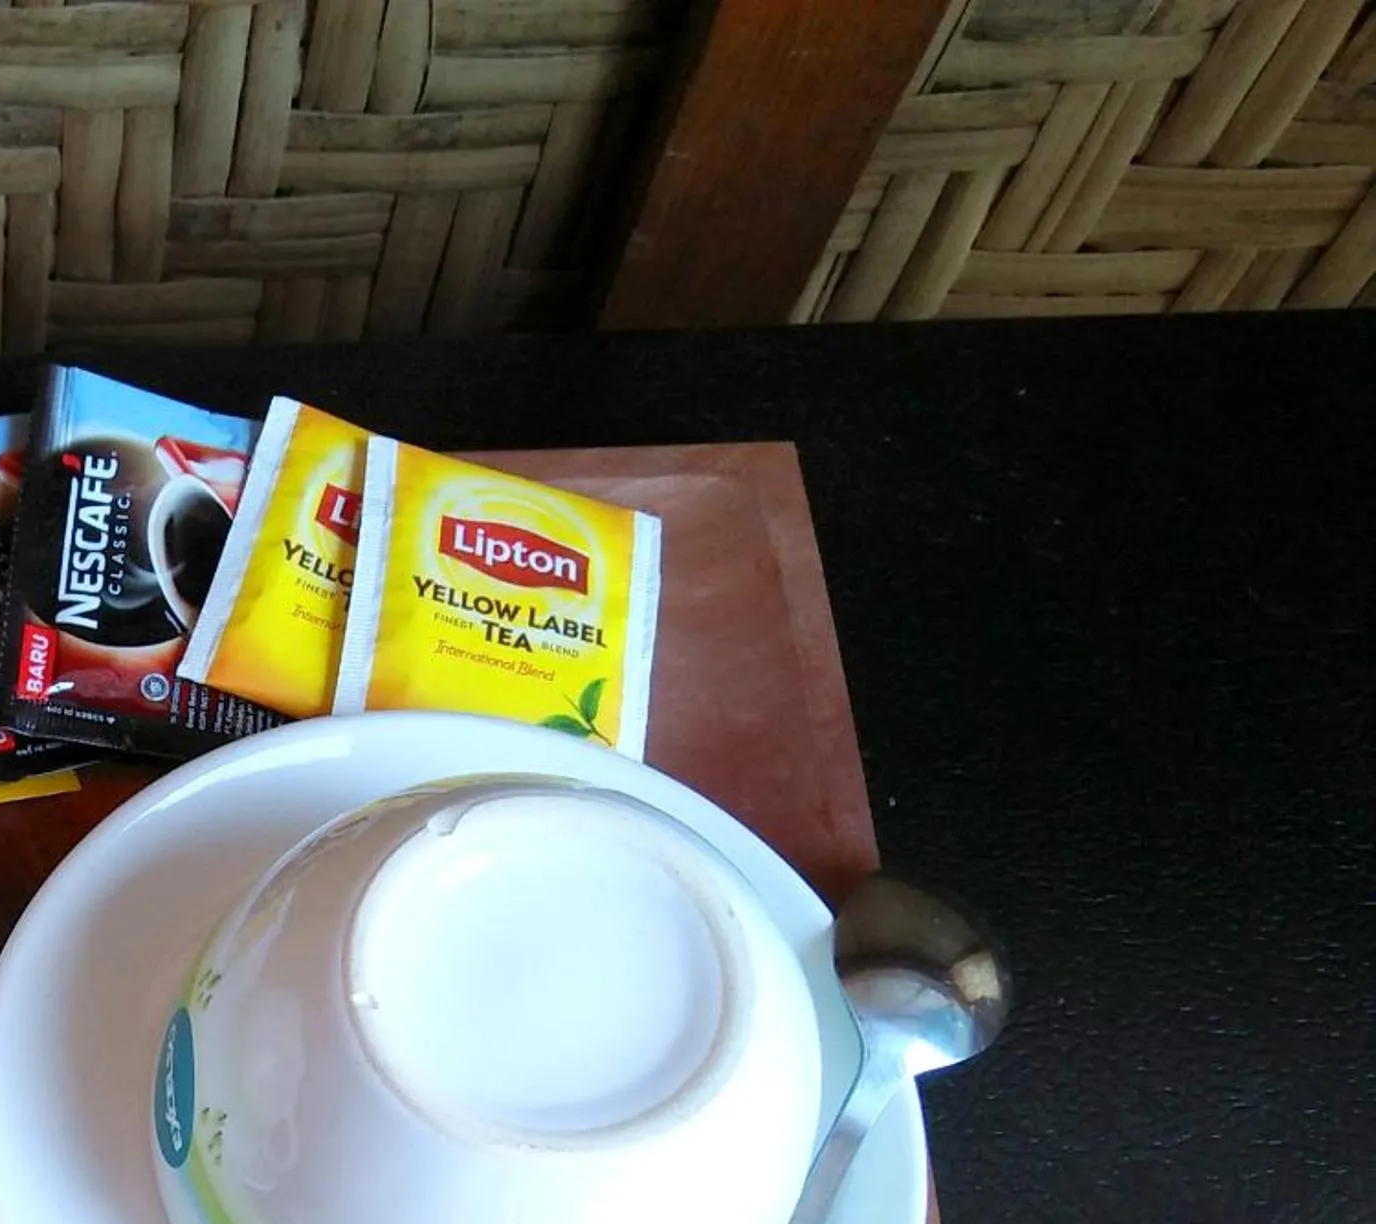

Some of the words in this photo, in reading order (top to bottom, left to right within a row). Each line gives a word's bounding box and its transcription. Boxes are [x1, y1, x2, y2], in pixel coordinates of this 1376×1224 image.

[108, 497, 131, 596] CLASSIC
[283, 538, 355, 587] YELLO
[453, 523, 577, 582] Lipton
[412, 574, 521, 623] YELLOW
[528, 606, 608, 649] LABEL
[433, 612, 475, 631] FINEST
[481, 619, 534, 653] TEA
[541, 642, 580, 659] BLEND
[26, 633, 50, 693] BARU
[434, 639, 517, 674] International
[516, 660, 556, 683] Blend
